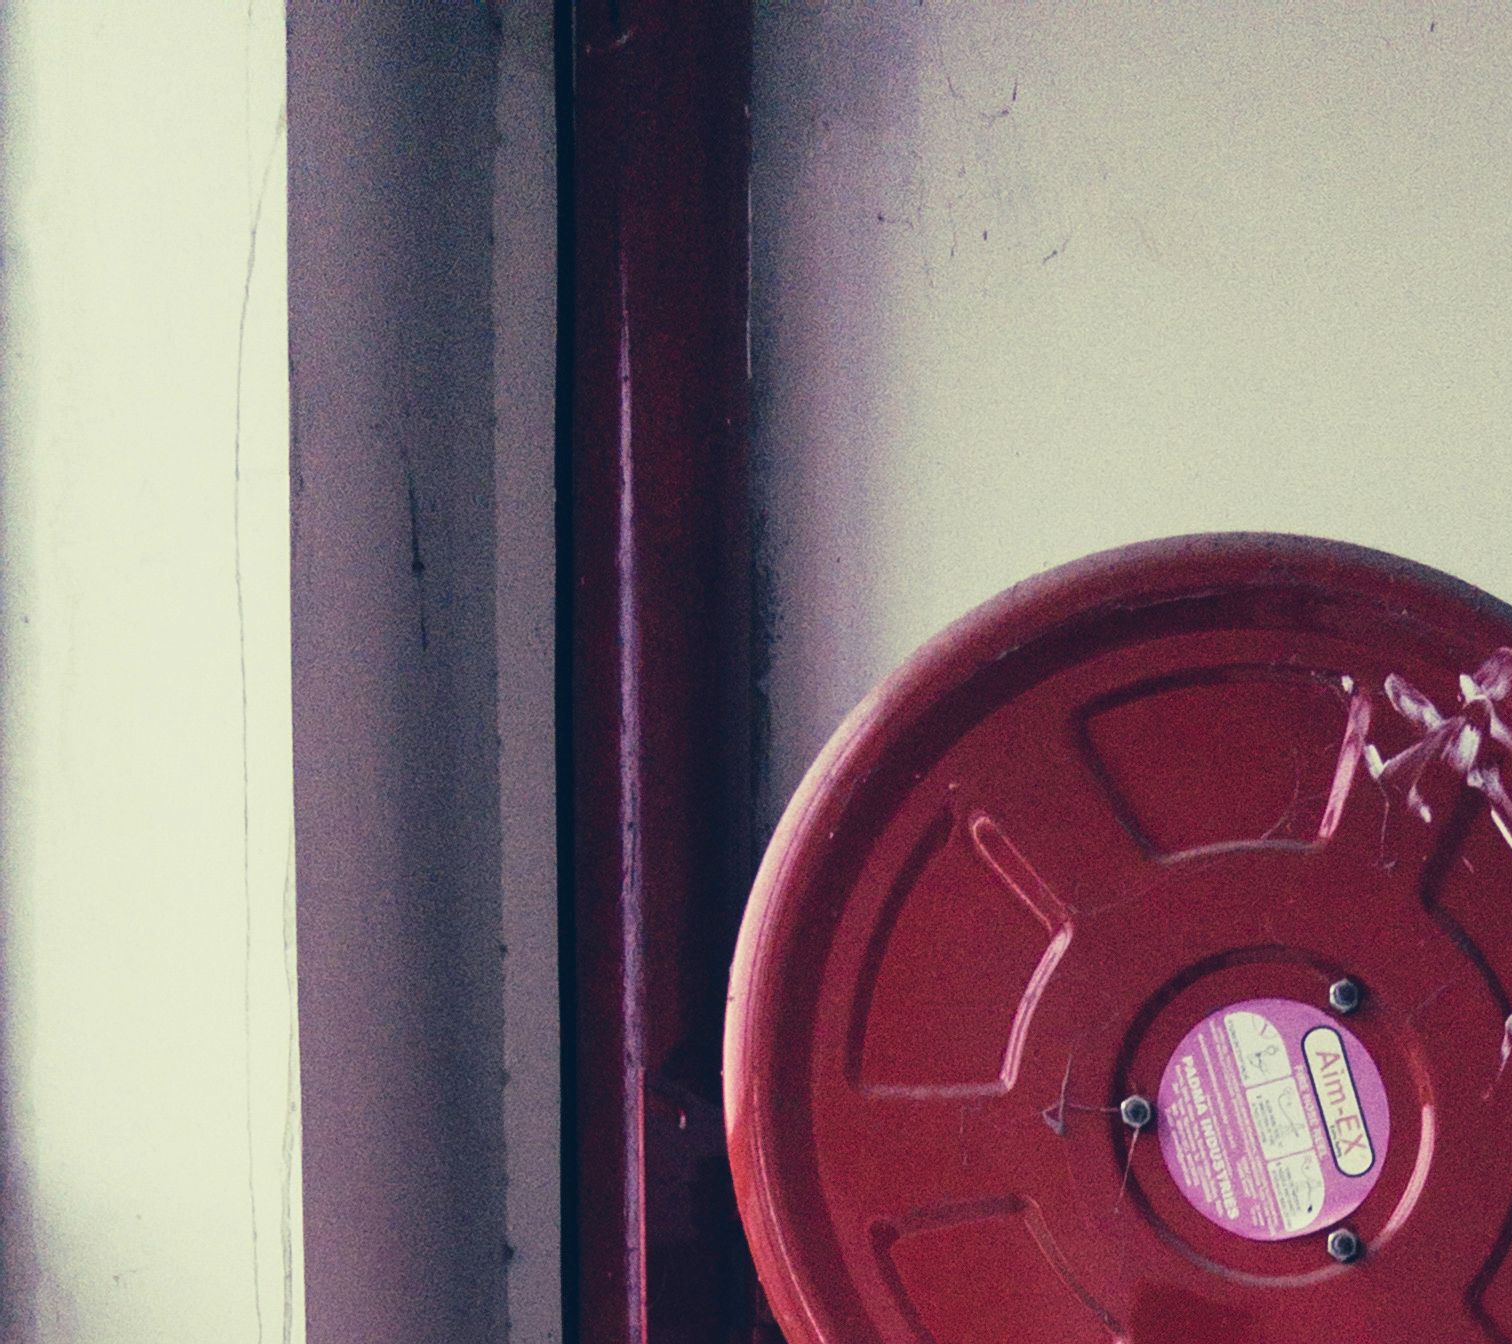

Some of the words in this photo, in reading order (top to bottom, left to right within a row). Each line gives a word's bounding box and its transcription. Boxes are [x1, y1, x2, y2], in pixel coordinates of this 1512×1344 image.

[1182, 1055, 1209, 1115] PADMA
[1201, 1117, 1239, 1220] INDUSTRIES
[1315, 1049, 1367, 1156] Aim-EX
